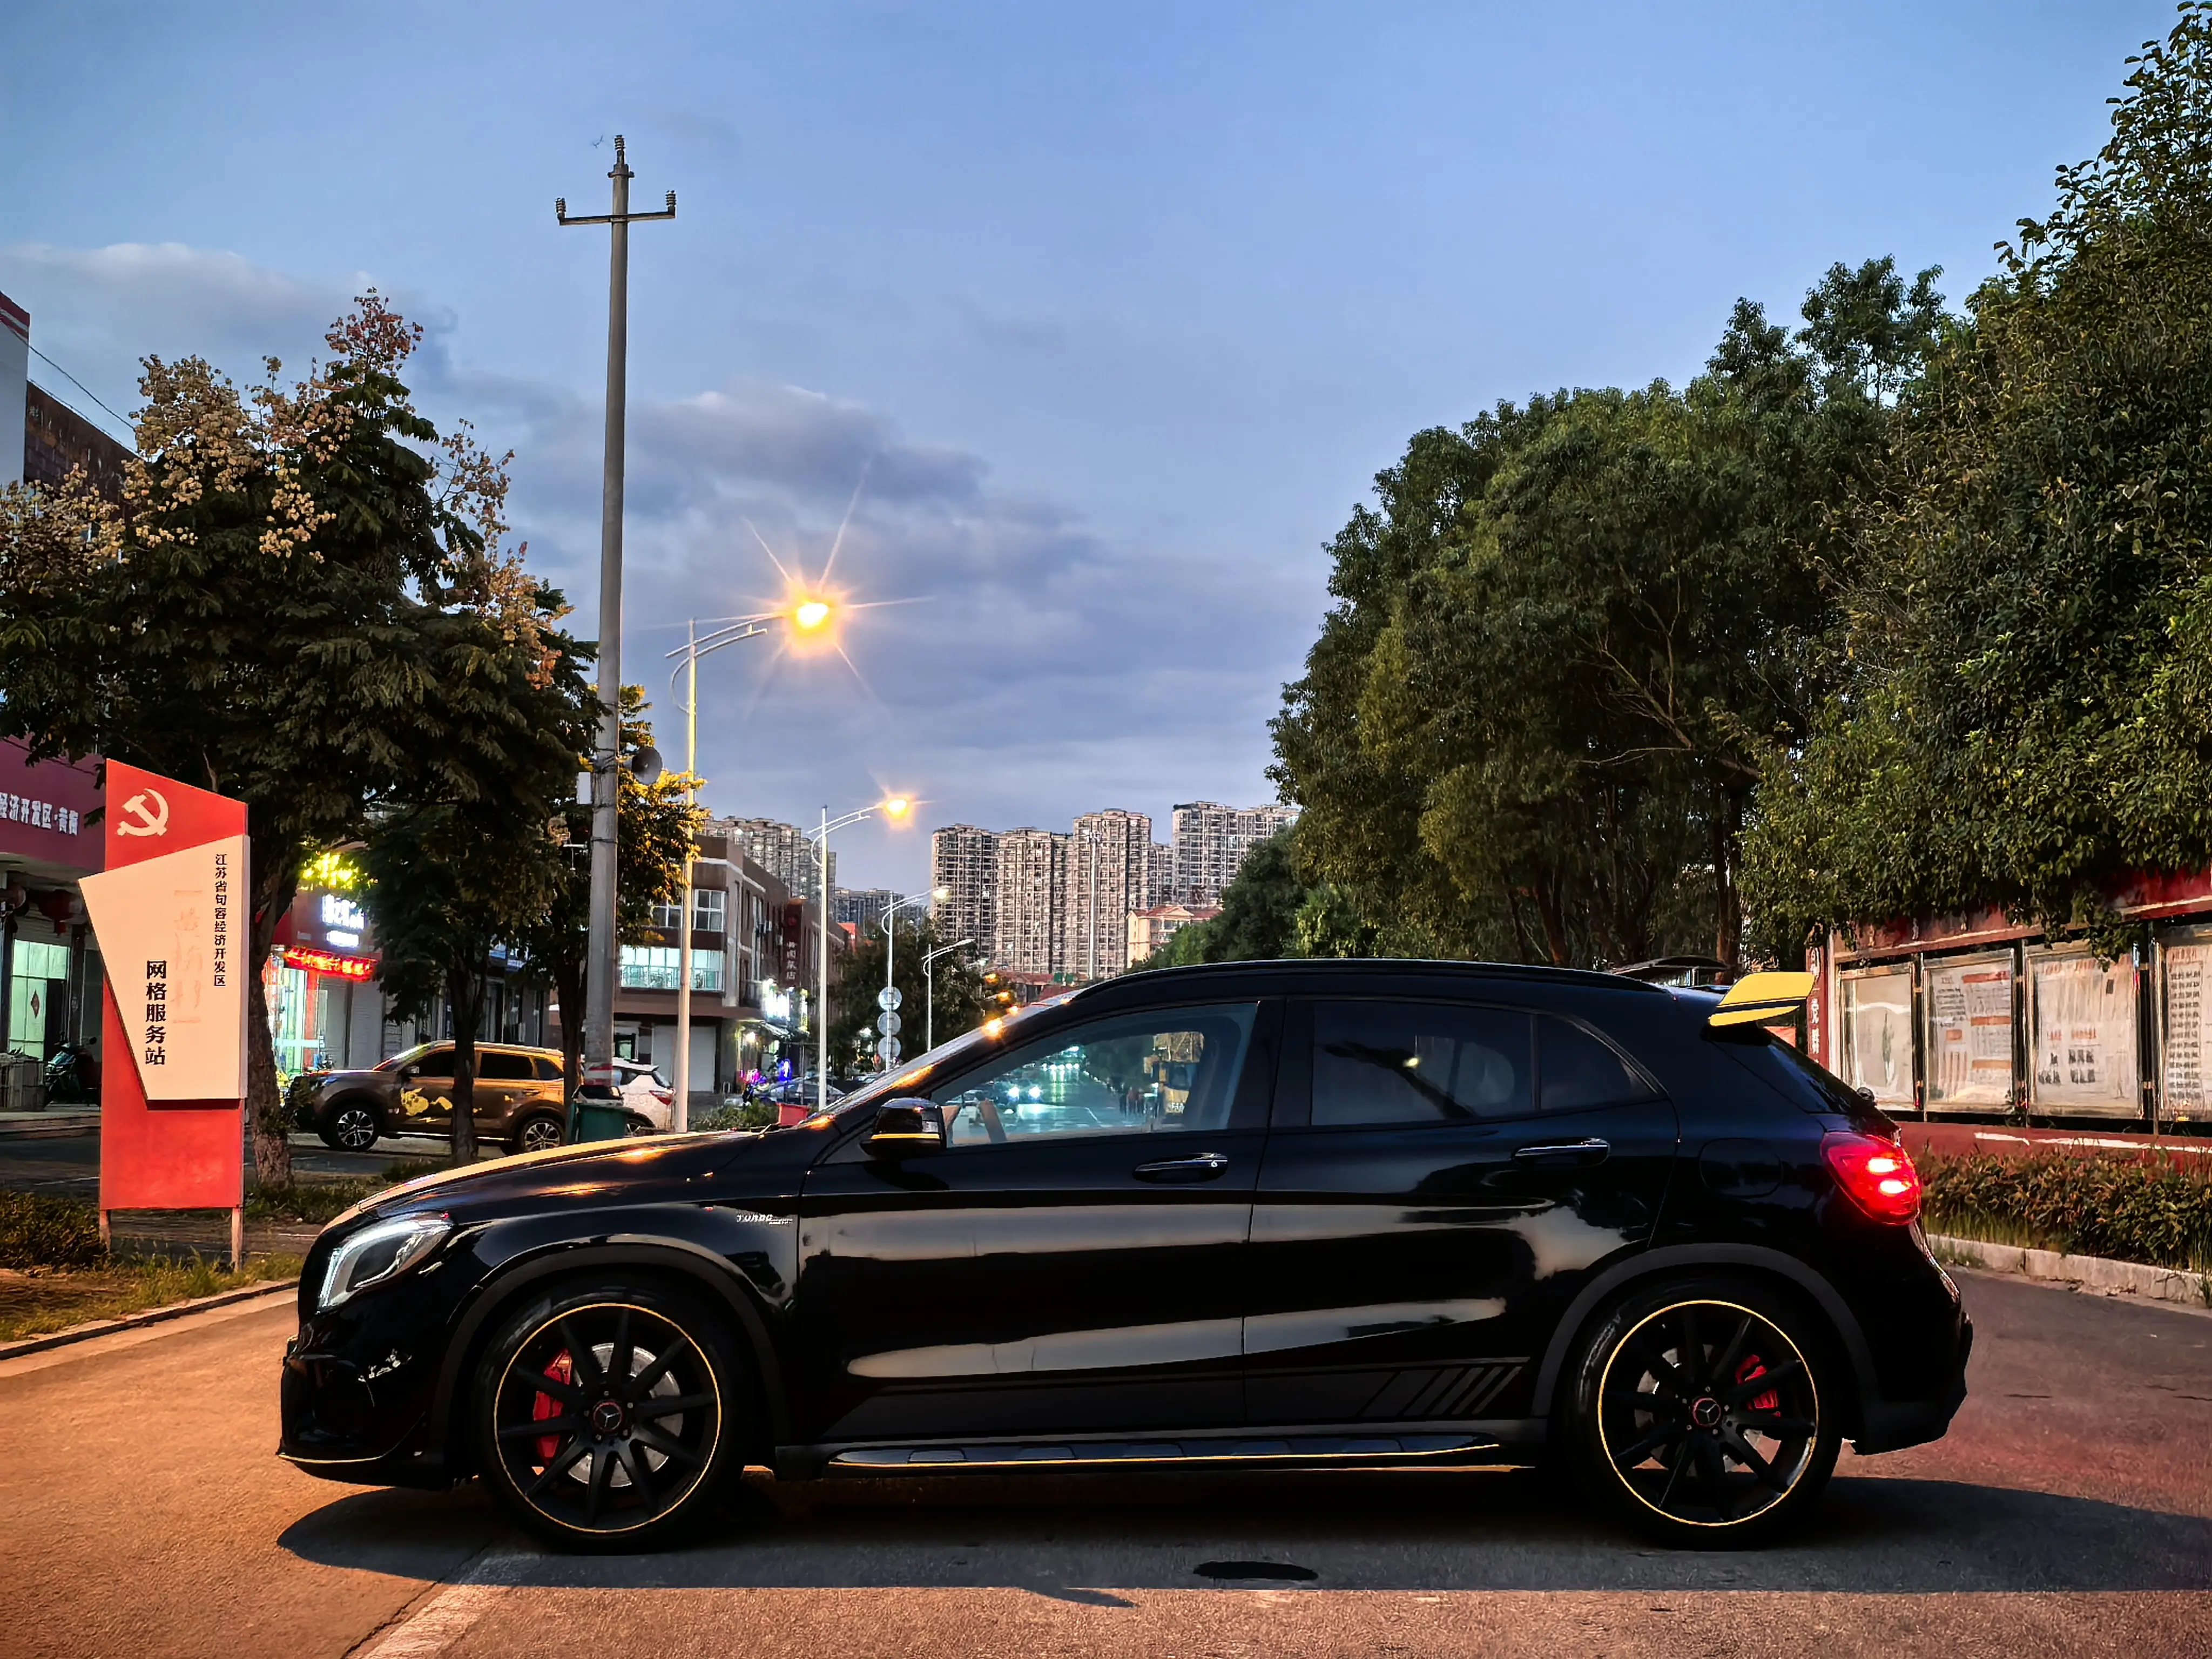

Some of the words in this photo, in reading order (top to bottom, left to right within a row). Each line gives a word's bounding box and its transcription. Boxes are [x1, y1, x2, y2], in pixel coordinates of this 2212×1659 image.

[214, 853, 227, 987] 江苏省句容经济开发区
[145, 960, 167, 1065] 网格服务站
